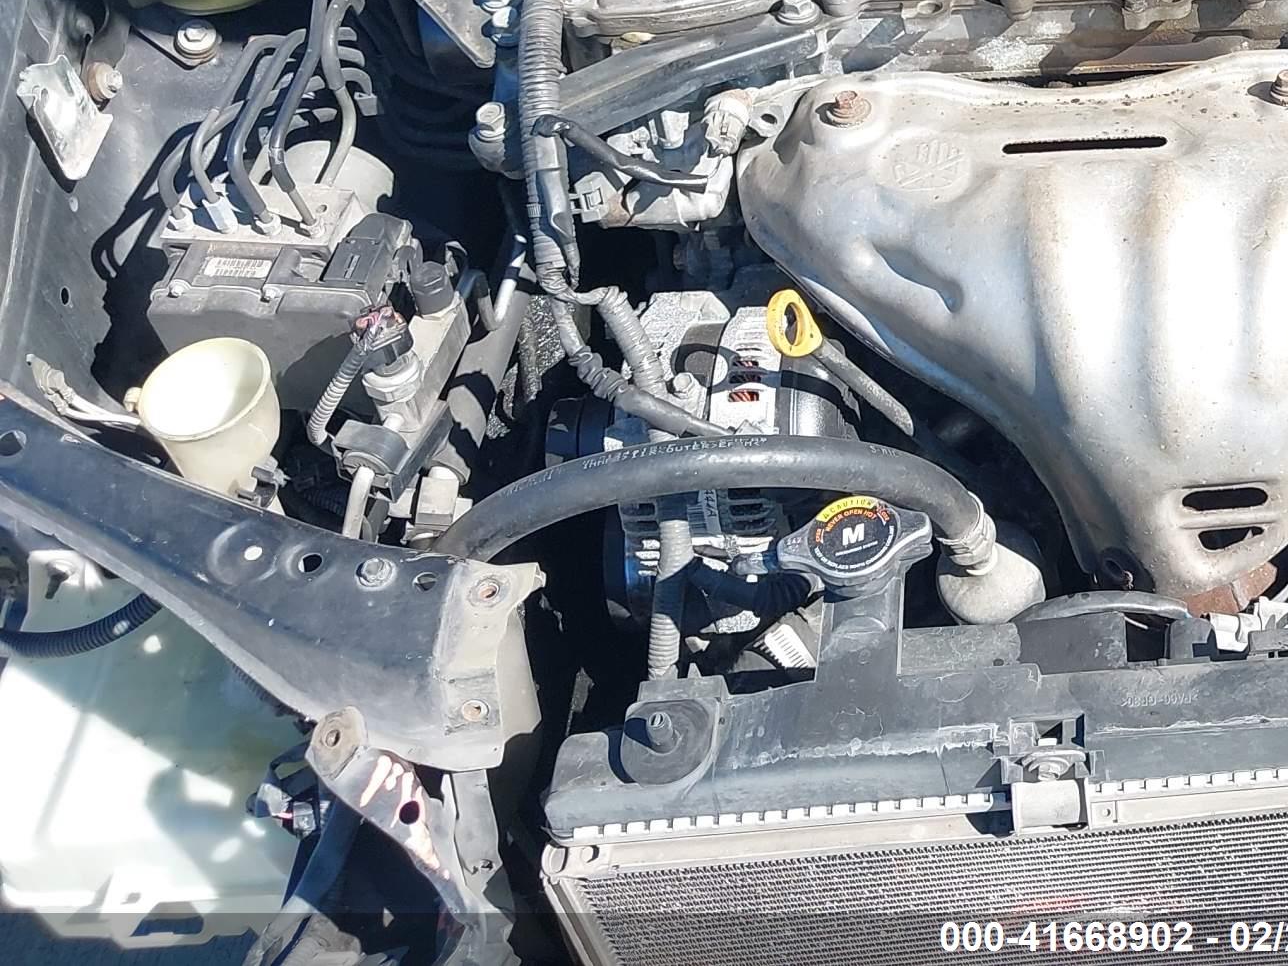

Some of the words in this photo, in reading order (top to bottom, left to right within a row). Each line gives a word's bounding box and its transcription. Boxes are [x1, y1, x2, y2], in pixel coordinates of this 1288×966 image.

[829, 498, 872, 513] CAUTION
[825, 513, 843, 532] NEVER
[843, 508, 863, 517] OPEN
[863, 509, 877, 520] HOT
[842, 523, 865, 546] M
